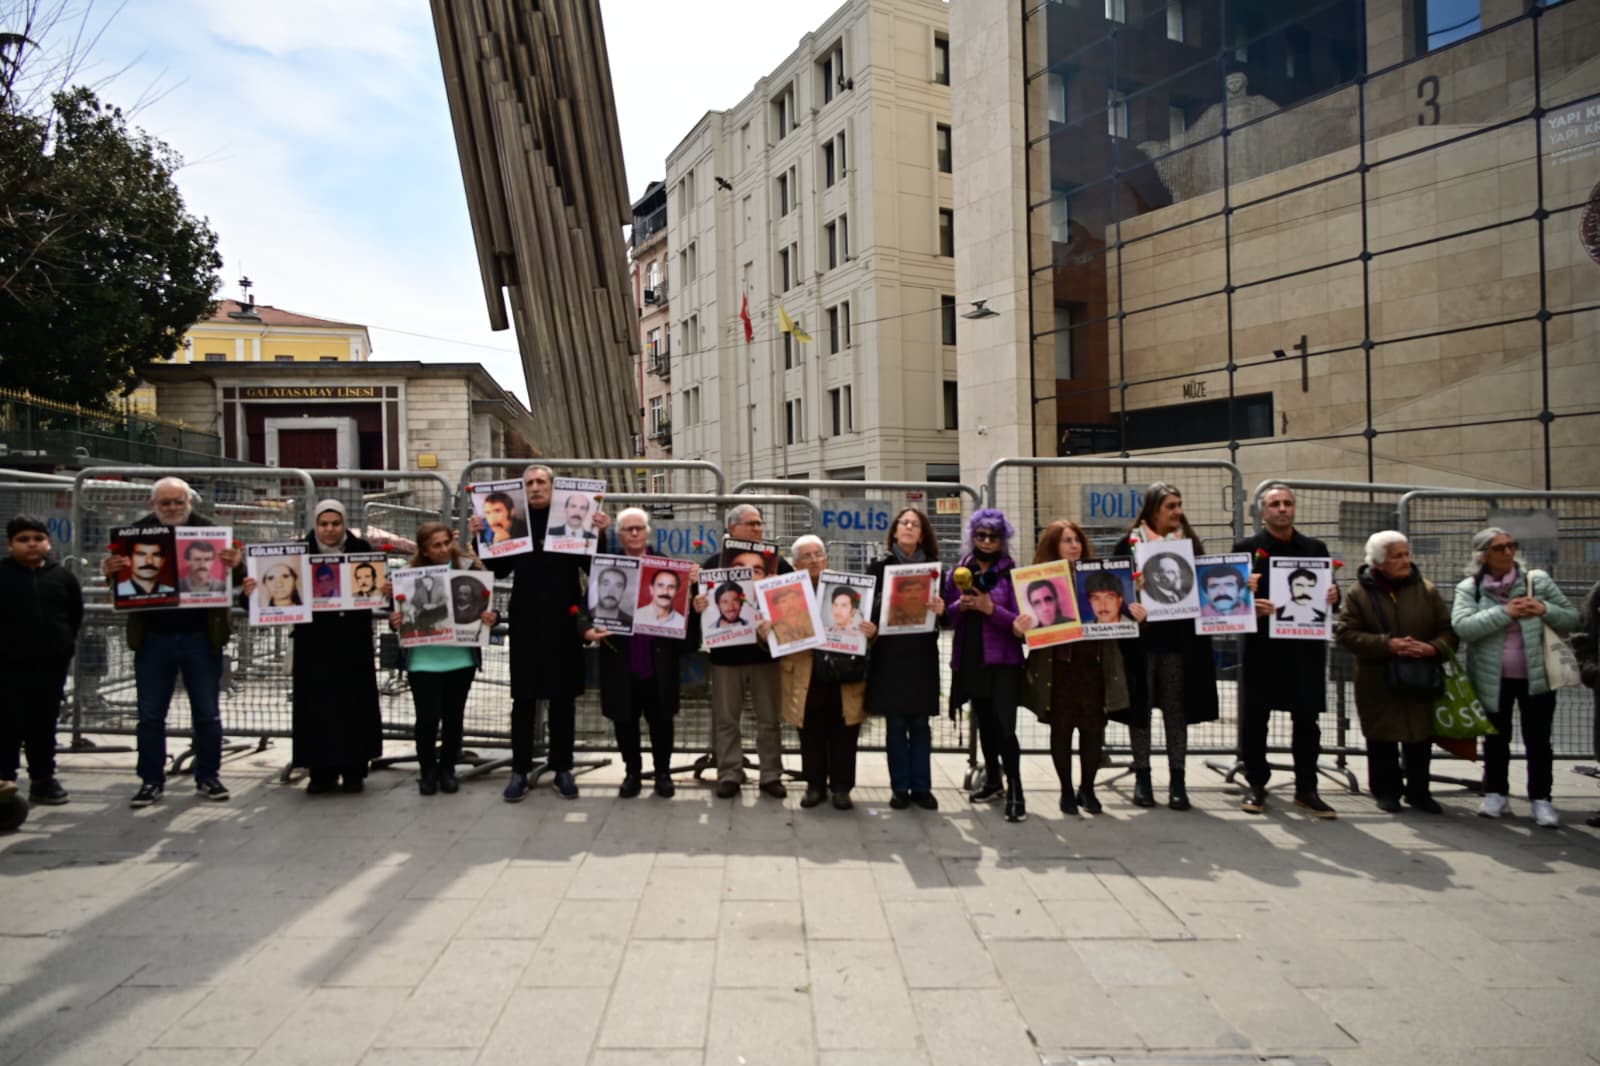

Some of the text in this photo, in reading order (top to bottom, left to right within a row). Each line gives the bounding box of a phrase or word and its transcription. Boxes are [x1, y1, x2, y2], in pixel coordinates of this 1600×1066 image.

[1417, 75, 1441, 126] 3
[1548, 110, 1582, 129] YAPI
[1550, 127, 1579, 145] YAPI
[246, 386, 375, 398] GALATASARAY LİSESİ
[1182, 379, 1207, 400] MÜZE
[822, 506, 889, 531] POLİS
[656, 524, 718, 556] POLİS
[700, 568, 752, 582] HASAN OCAK
